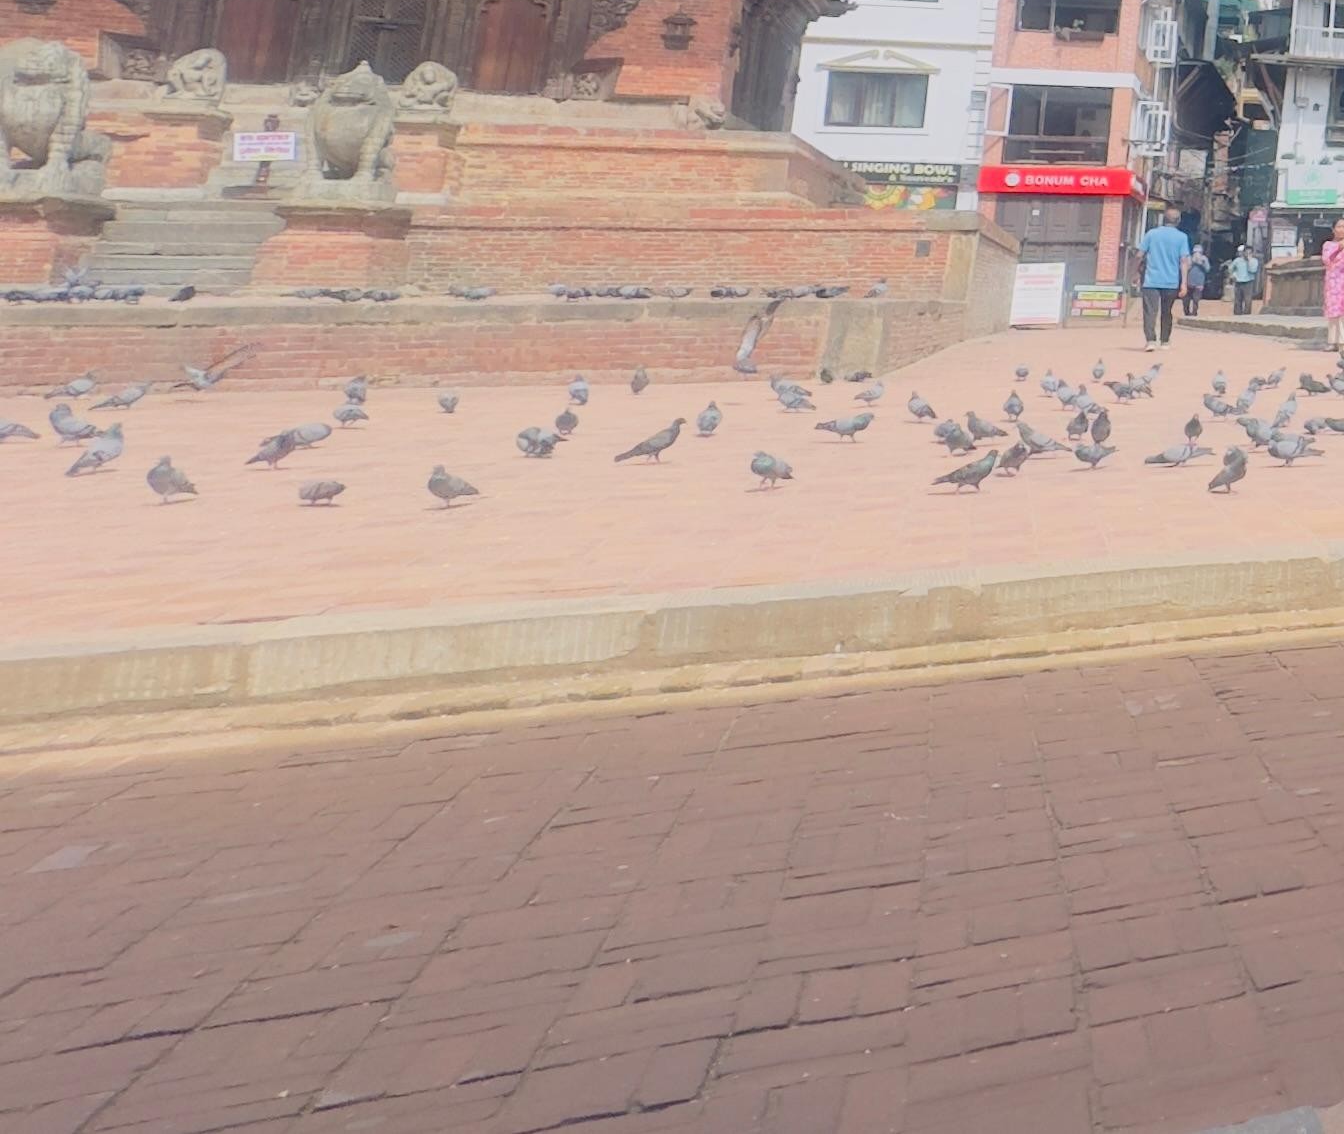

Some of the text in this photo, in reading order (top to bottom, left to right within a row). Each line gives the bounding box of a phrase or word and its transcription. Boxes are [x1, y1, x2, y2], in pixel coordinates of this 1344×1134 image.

[851, 161, 912, 175] SINGING
[913, 164, 957, 176] BOWL
[1025, 174, 1108, 187] BONUM CHA
